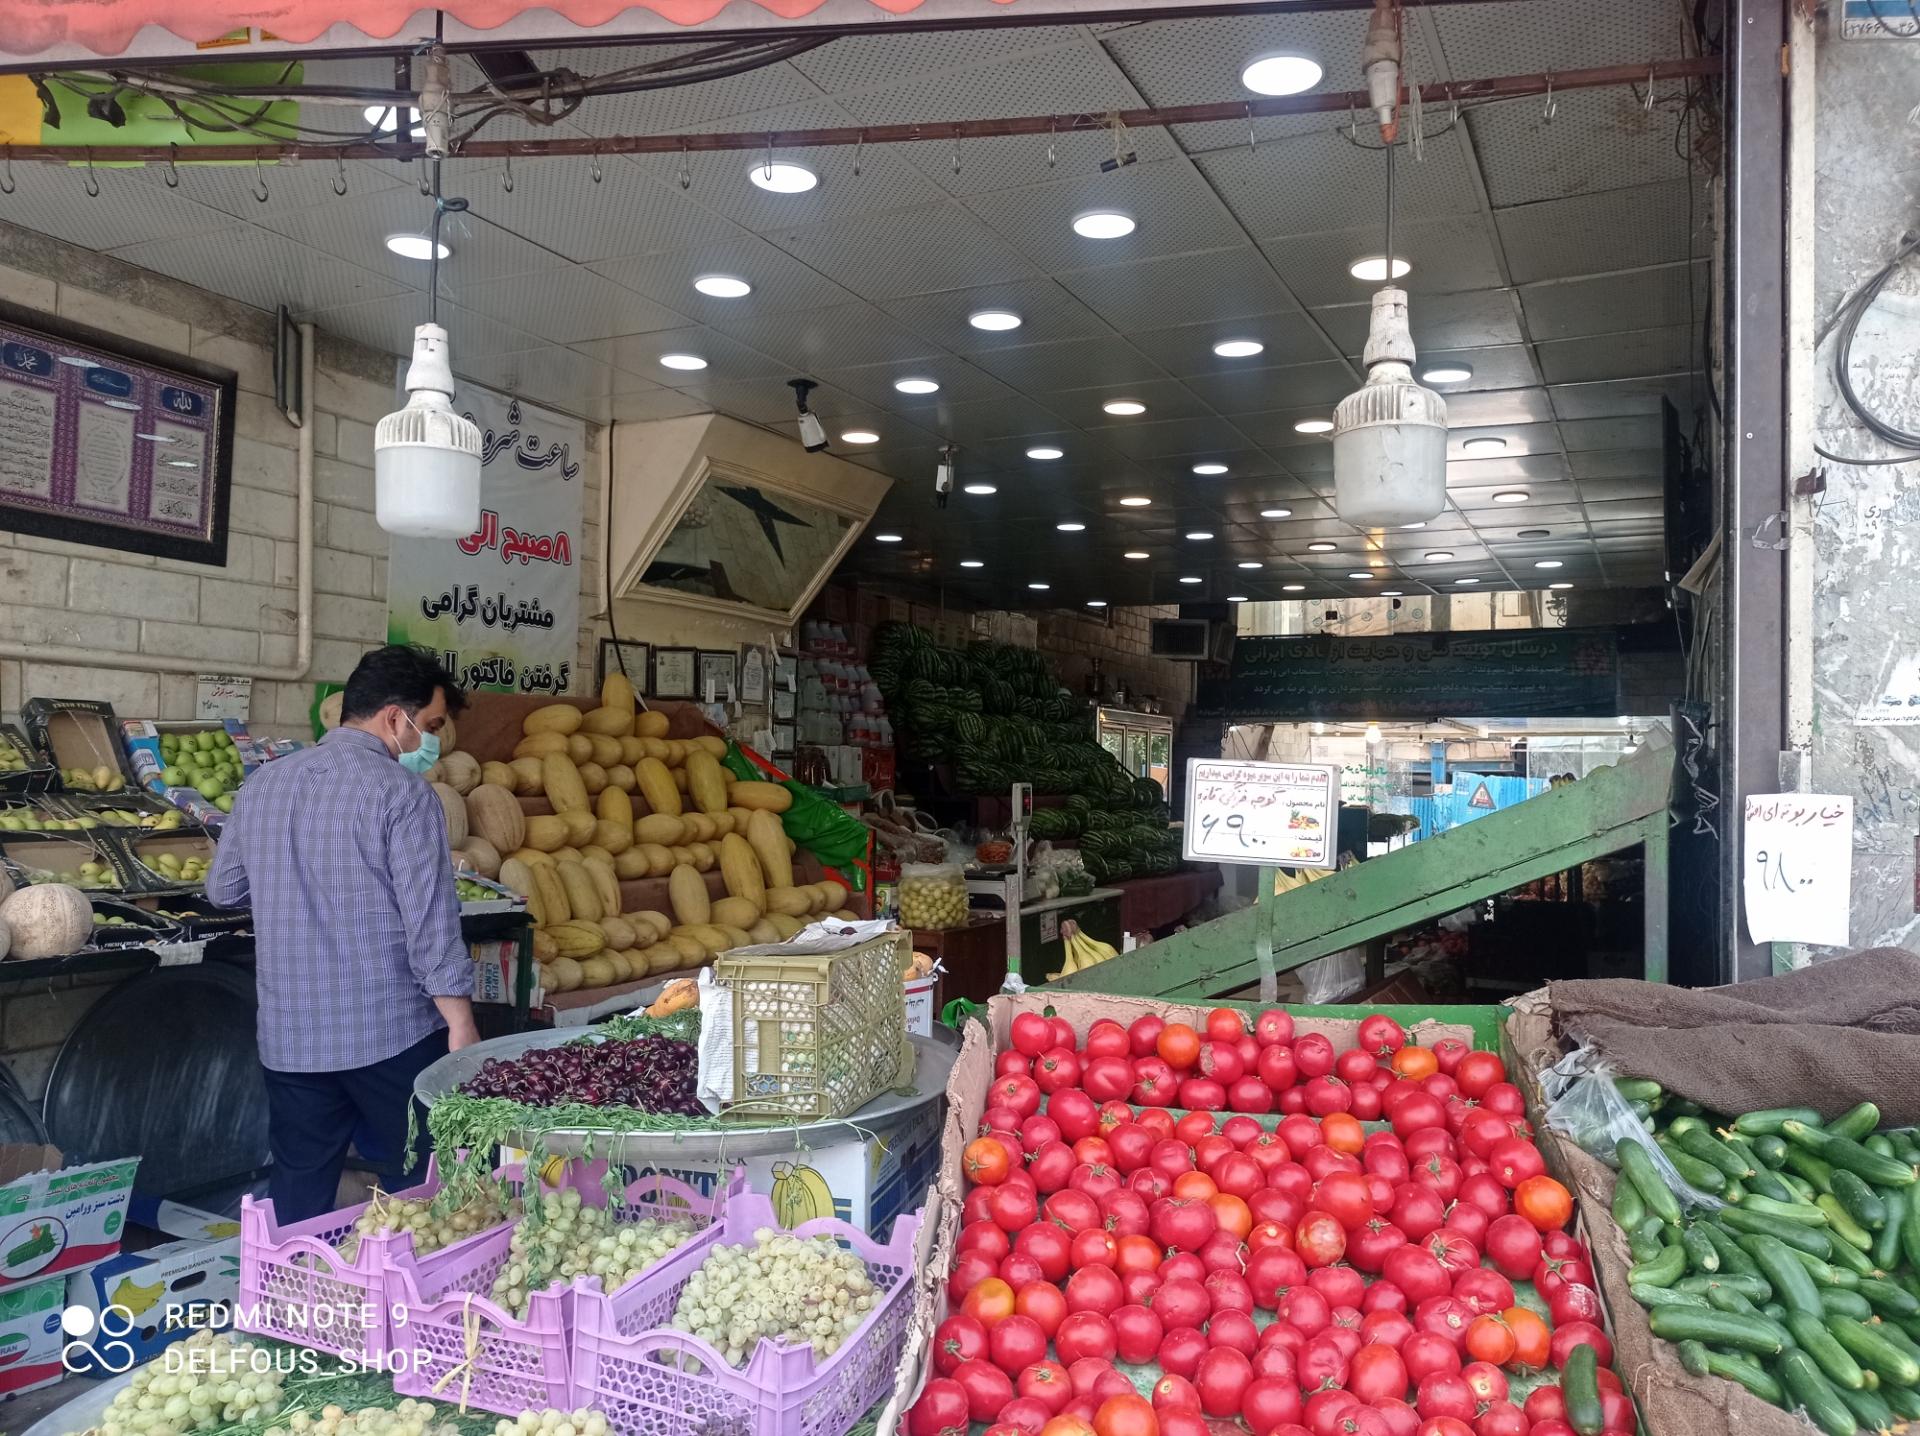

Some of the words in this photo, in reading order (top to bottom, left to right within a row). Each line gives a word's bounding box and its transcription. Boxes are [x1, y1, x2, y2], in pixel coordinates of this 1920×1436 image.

[515, 435, 579, 480] ساعت
[421, 584, 479, 625] گرامی
[481, 592, 555, 633] مشتریان
[1244, 644, 1285, 663] ایرانی
[1347, 641, 1400, 662] حمایت
[459, 655, 517, 690] فاکتور
[520, 660, 571, 696] گرفتن
[1223, 769, 1242, 780] گرامی
[1273, 770, 1285, 782] این
[1300, 772, 1310, 781] شما
[1315, 801, 1326, 809] نام
[1762, 801, 1779, 822] ای
[1781, 803, 1806, 827] بوته
[1802, 804, 1845, 827] خیار
[1756, 850, 1814, 894] ۹۸۰۰
[485, 962, 493, 1000] LEMON
[65, 1202, 92, 1219] ورامین
[93, 1200, 107, 1213] سبز
[160, 1264, 189, 1279] PREMIUM
[187, 1256, 216, 1272] BANANAS
